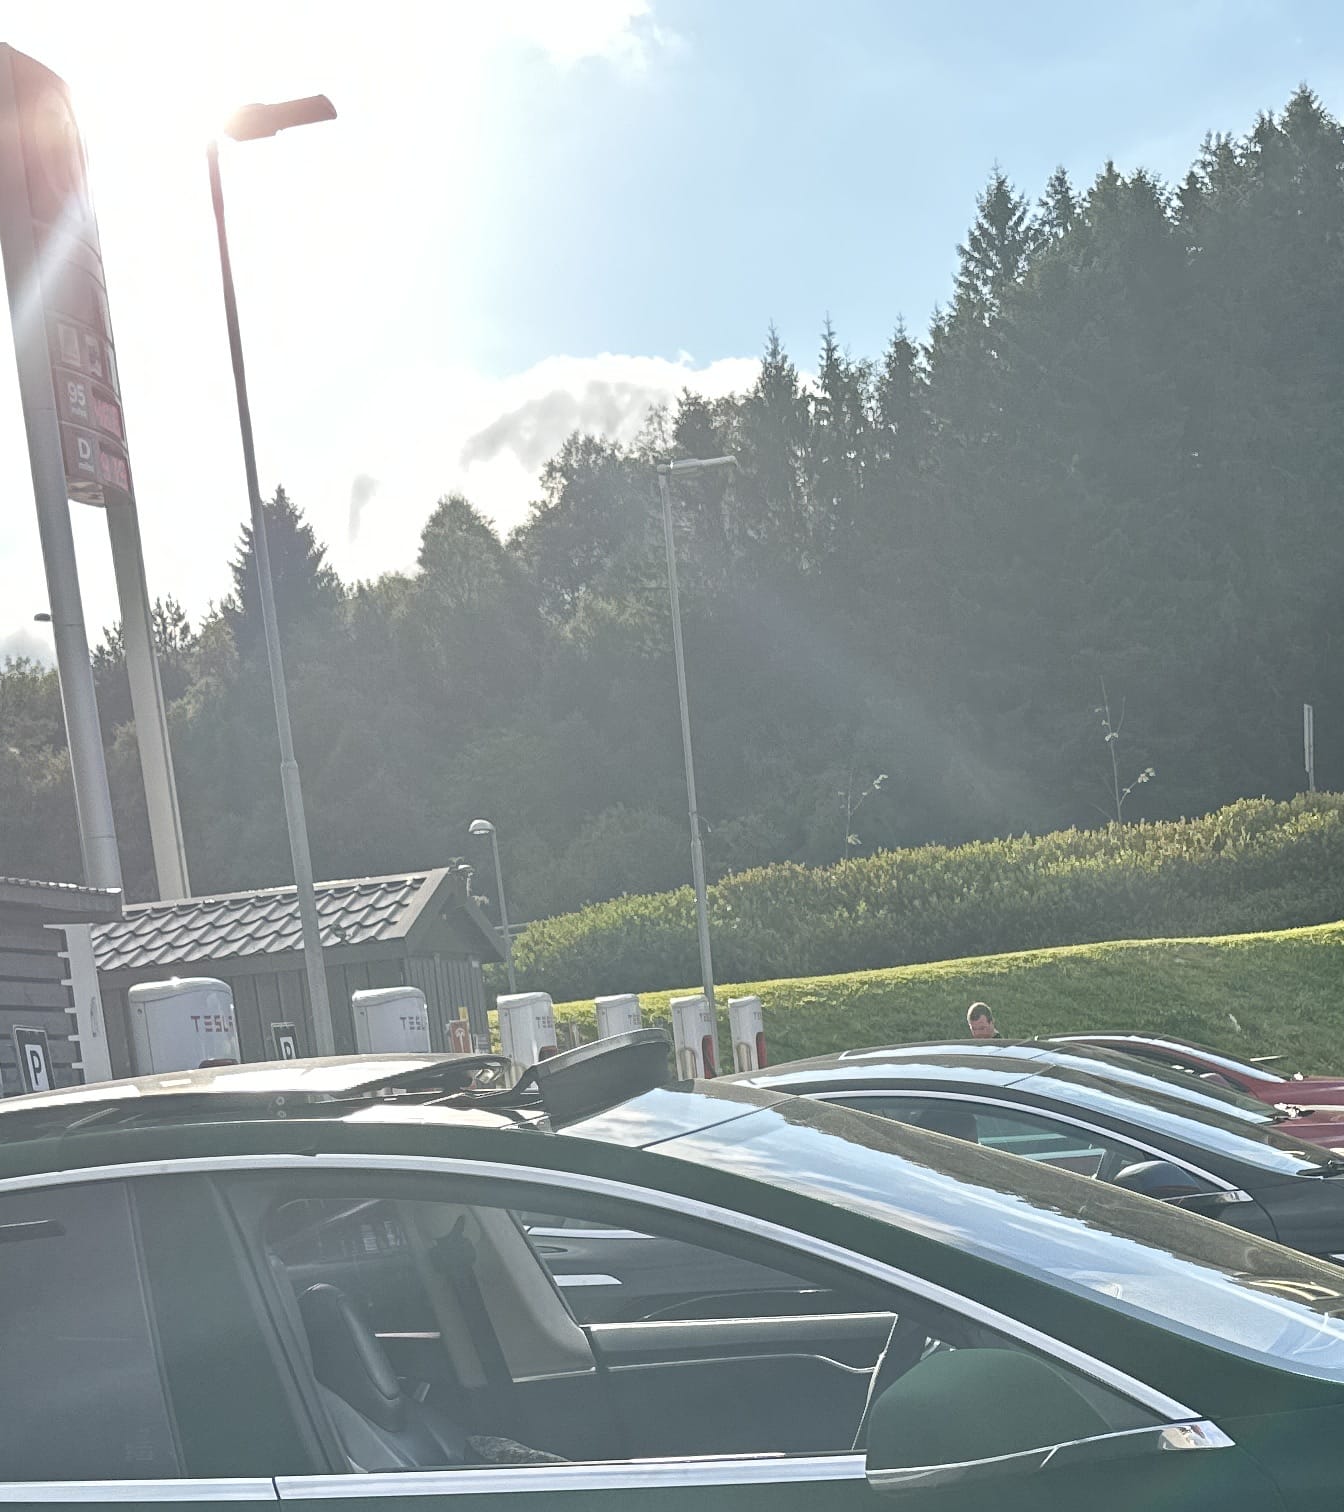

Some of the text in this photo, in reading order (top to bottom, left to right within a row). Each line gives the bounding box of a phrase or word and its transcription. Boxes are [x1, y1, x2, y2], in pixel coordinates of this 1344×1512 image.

[67, 381, 86, 406] 95
[78, 438, 91, 459] D
[190, 1015, 233, 1033] TESLA
[29, 1049, 42, 1086] P
